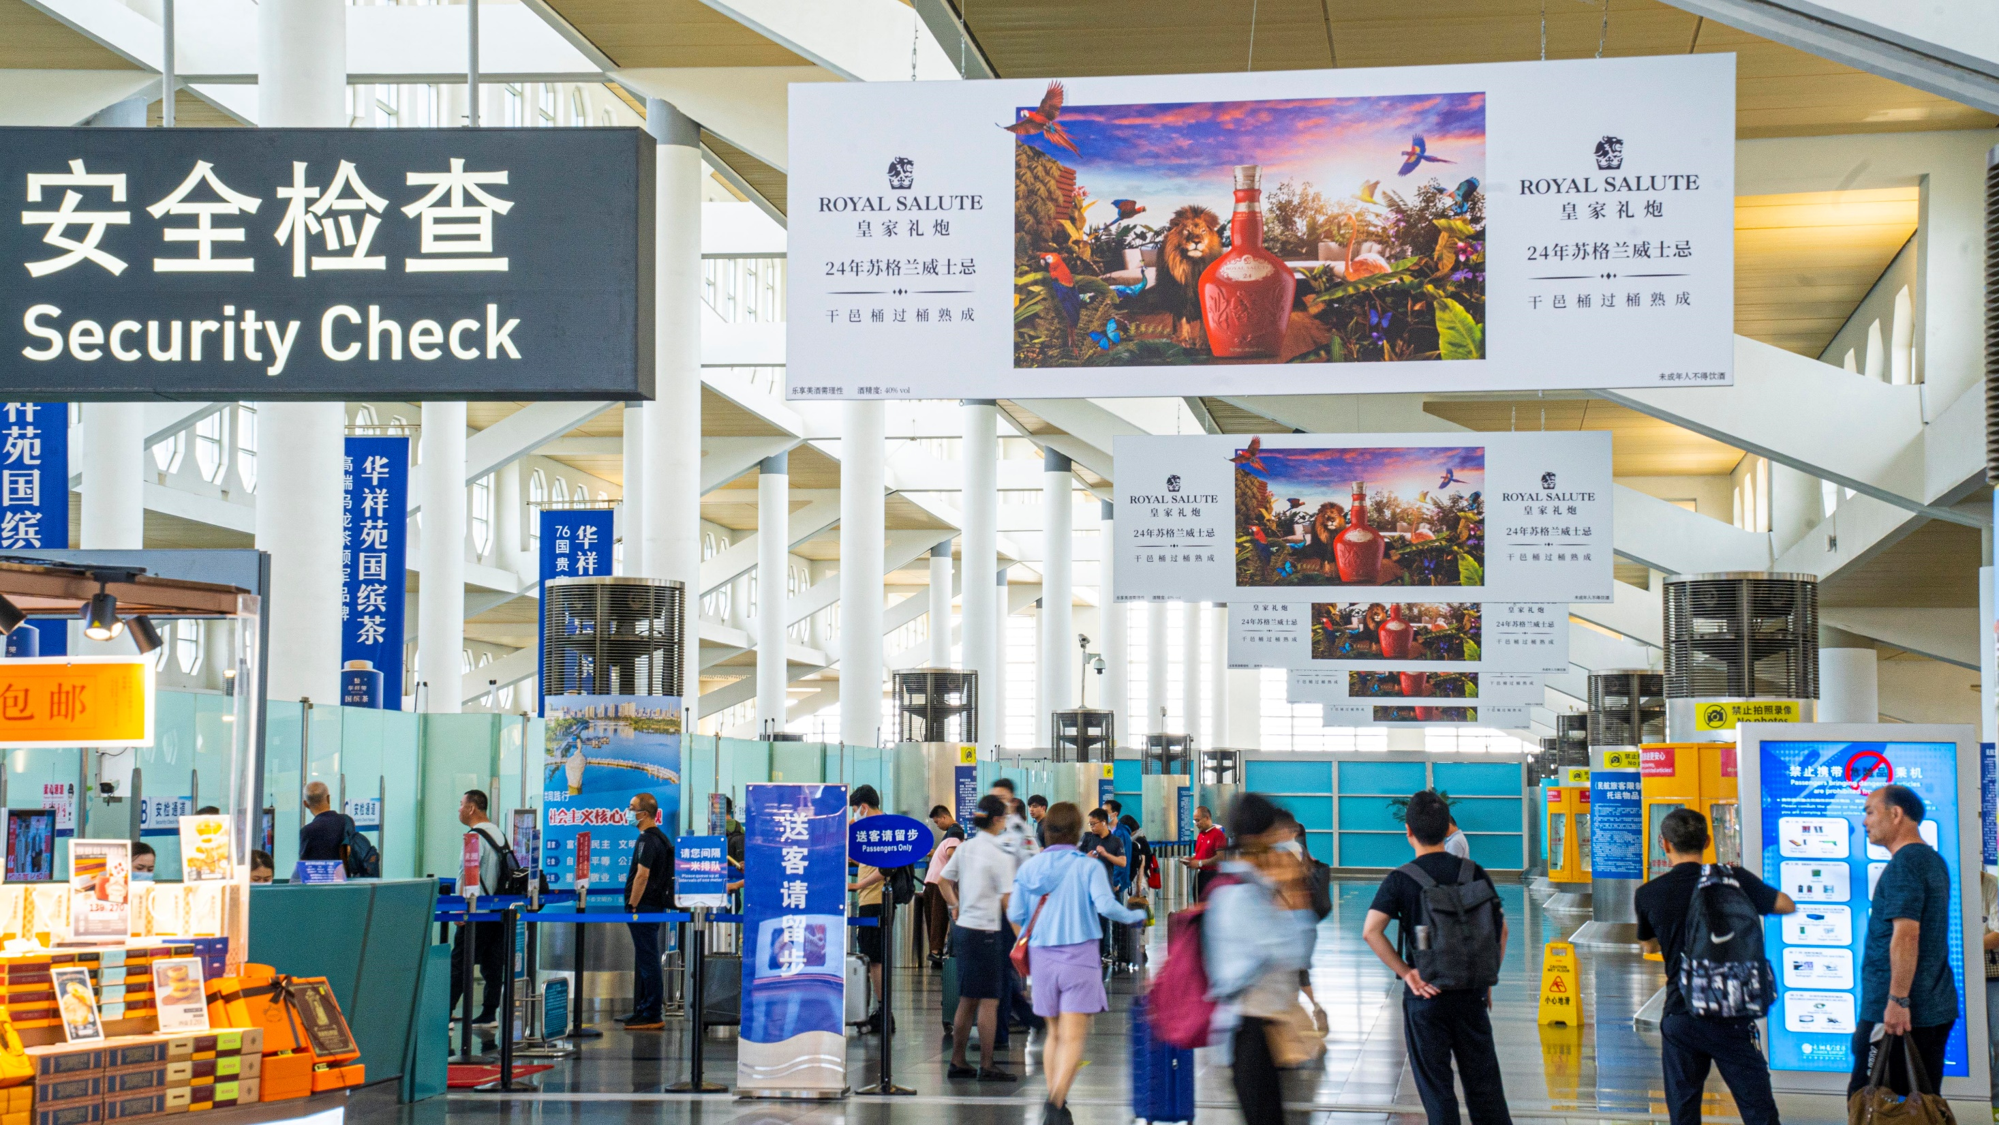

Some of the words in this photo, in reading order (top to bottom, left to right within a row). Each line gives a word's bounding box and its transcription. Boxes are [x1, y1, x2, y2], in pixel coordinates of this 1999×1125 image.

[1519, 177, 1598, 195] ROYAL
[1604, 174, 1700, 193] SALUTE
[818, 195, 891, 213] ROYAL
[896, 194, 984, 212] SALUTE
[1560, 200, 1664, 221] 皇家礼炮
[21, 158, 515, 278] 安全检查
[856, 219, 951, 238] 皇家礼炮
[1527, 240, 1692, 261] 24年苏格兰威士忌
[825, 258, 977, 277] 24年苏格兰威士忌
[1528, 291, 1691, 310] 干邑桶过桶熟成
[825, 307, 975, 323] 干邑桶过桶熟成
[21, 304, 300, 376] Security
[320, 304, 522, 361] Check
[1659, 371, 1726, 381] 未成年人不得饮酒
[792, 386, 844, 395] 乐享美酒需理性
[1130, 495, 1168, 504] ROYAL
[1171, 495, 1218, 504] SALUTE
[1502, 492, 1543, 502] ROYAL
[1545, 492, 1596, 501] SALUTE
[1149, 507, 1201, 518] 皇家礼炮
[1523, 505, 1577, 515] 皇家礼炮
[1133, 528, 1216, 538] 24年苏格兰威士忌
[1506, 526, 1592, 536] 24年苏格兰威士忌
[356, 455, 390, 645] 华祥苑国缤茶
[575, 525, 598, 575] 华祥
[1134, 554, 1215, 563] 干邑桶过桶熟成
[1507, 553, 1592, 561] 干邑桶过桶熟成
[0, 683, 86, 723] 包邮
[1732, 705, 1792, 716] 禁止拍照录像
[1790, 766, 1843, 778] 禁止携带
[1895, 766, 1923, 779] 乘机
[1790, 779, 1827, 787] Passengers
[856, 828, 919, 843] 送客请留步
[680, 848, 721, 859] 请您间隔
[862, 844, 897, 853] Passengers
[898, 844, 913, 852] Only
[680, 861, 721, 872] 一米排队
[780, 812, 809, 978] 送客请留步
[1545, 996, 1570, 1005] 小心地滑
